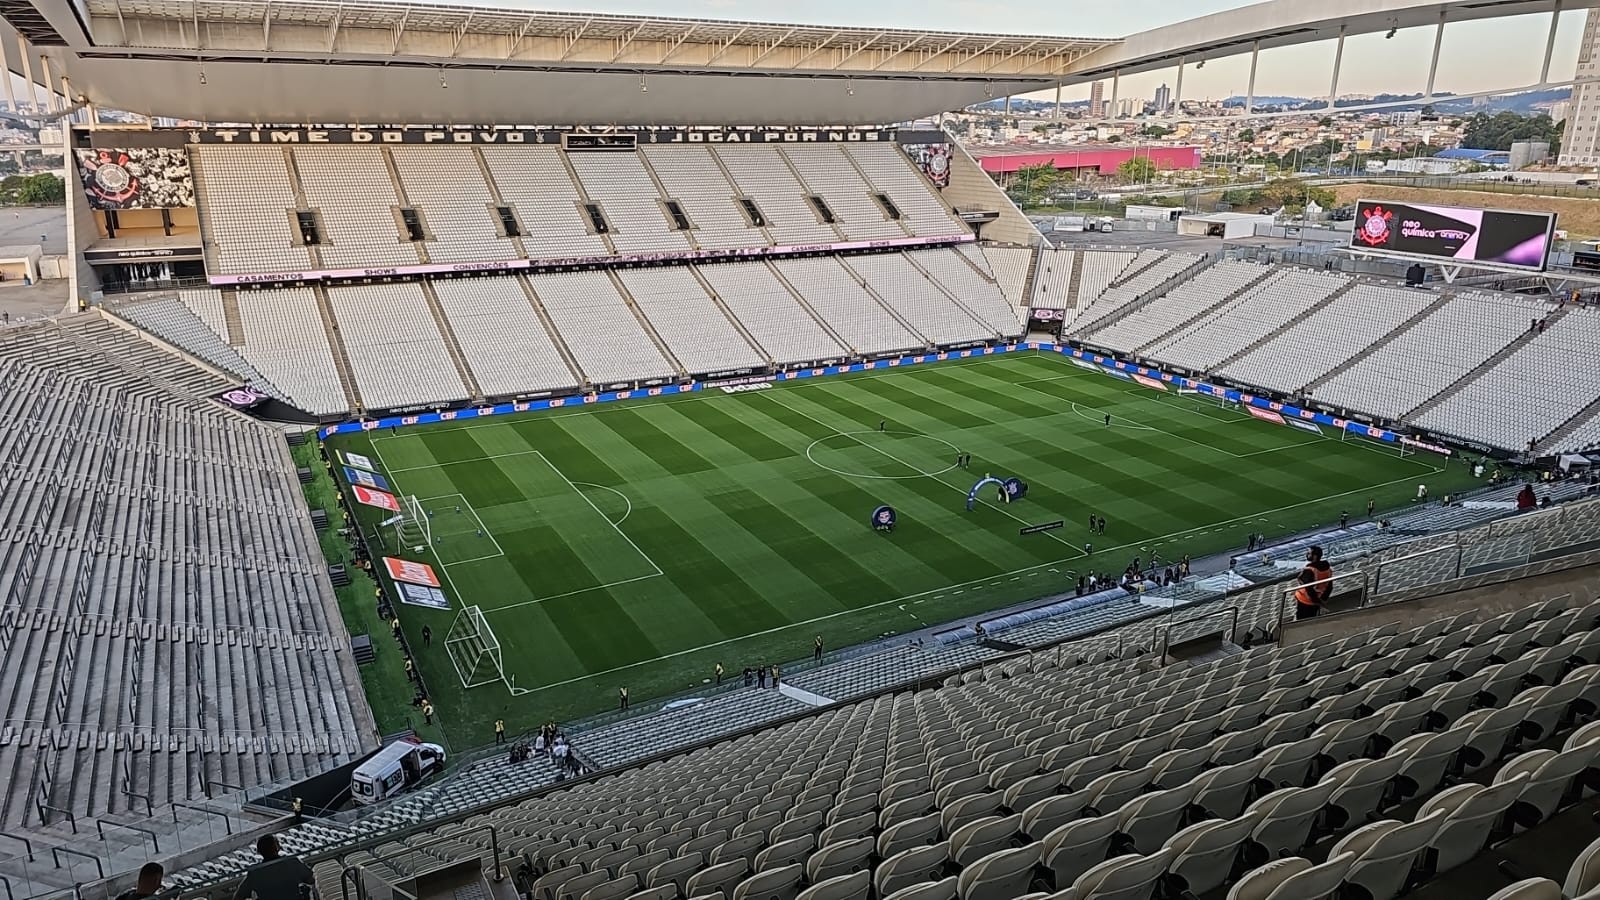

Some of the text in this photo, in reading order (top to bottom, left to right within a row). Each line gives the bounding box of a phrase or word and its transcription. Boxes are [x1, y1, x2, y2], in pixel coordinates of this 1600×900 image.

[215, 131, 524, 143] TIME DO POVO
[671, 132, 751, 142] JOGAI
[765, 132, 818, 142] POR
[1402, 220, 1421, 229] neo
[236, 261, 510, 283] CASAMENTOS SHOWS CONVENÇÕES
[361, 420, 380, 430] CBF
[401, 416, 420, 425] CBF
[440, 411, 458, 420] CBF
[477, 407, 495, 416] CBF
[513, 403, 531, 412] CBF
[549, 399, 565, 407] CBF
[583, 394, 599, 404] CBF
[616, 391, 631, 400] CBF
[648, 388, 663, 396] CBF
[679, 384, 694, 392] CBF
[1269, 402, 1283, 411] CBF
[1300, 409, 1315, 419] CBF
[1367, 427, 1384, 438] CBF
